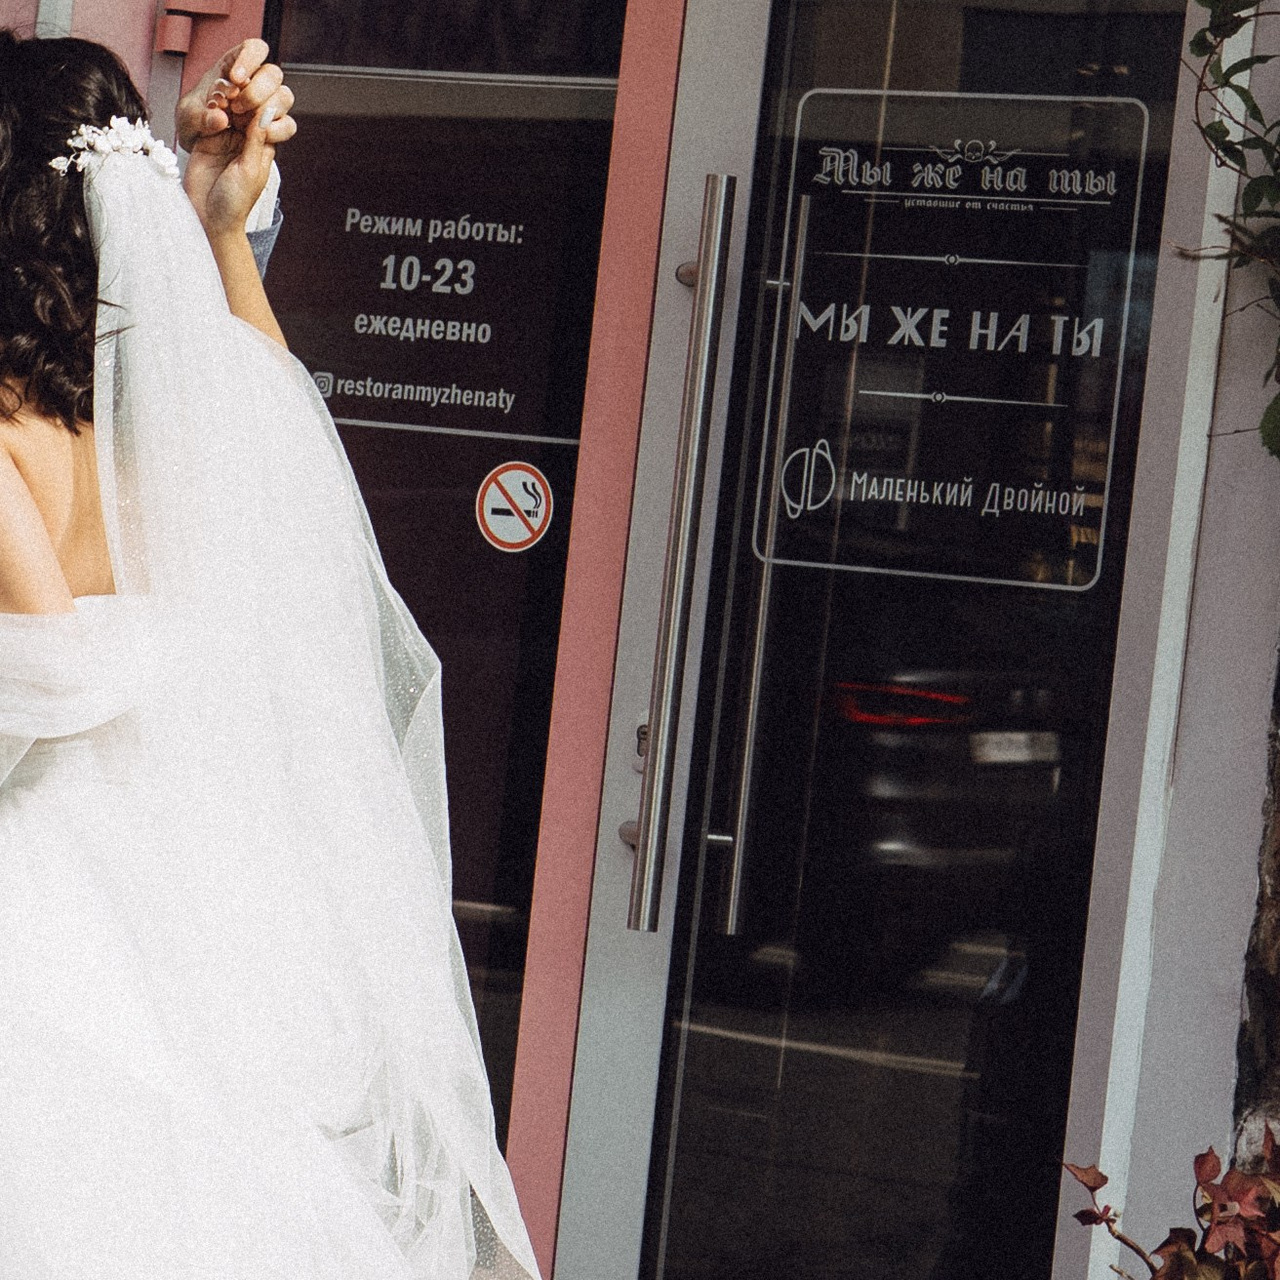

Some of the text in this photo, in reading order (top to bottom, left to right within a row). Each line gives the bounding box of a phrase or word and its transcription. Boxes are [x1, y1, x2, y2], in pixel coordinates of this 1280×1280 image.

[811, 146, 1118, 196] Мы же на ты
[345, 208, 525, 244] Режим работы:
[379, 254, 477, 295] 10-23
[354, 313, 492, 344] ежедневно
[796, 301, 1104, 358] МЫ ЖЕ НА ТЫ
[336, 377, 516, 414] restoranmyzhenaty
